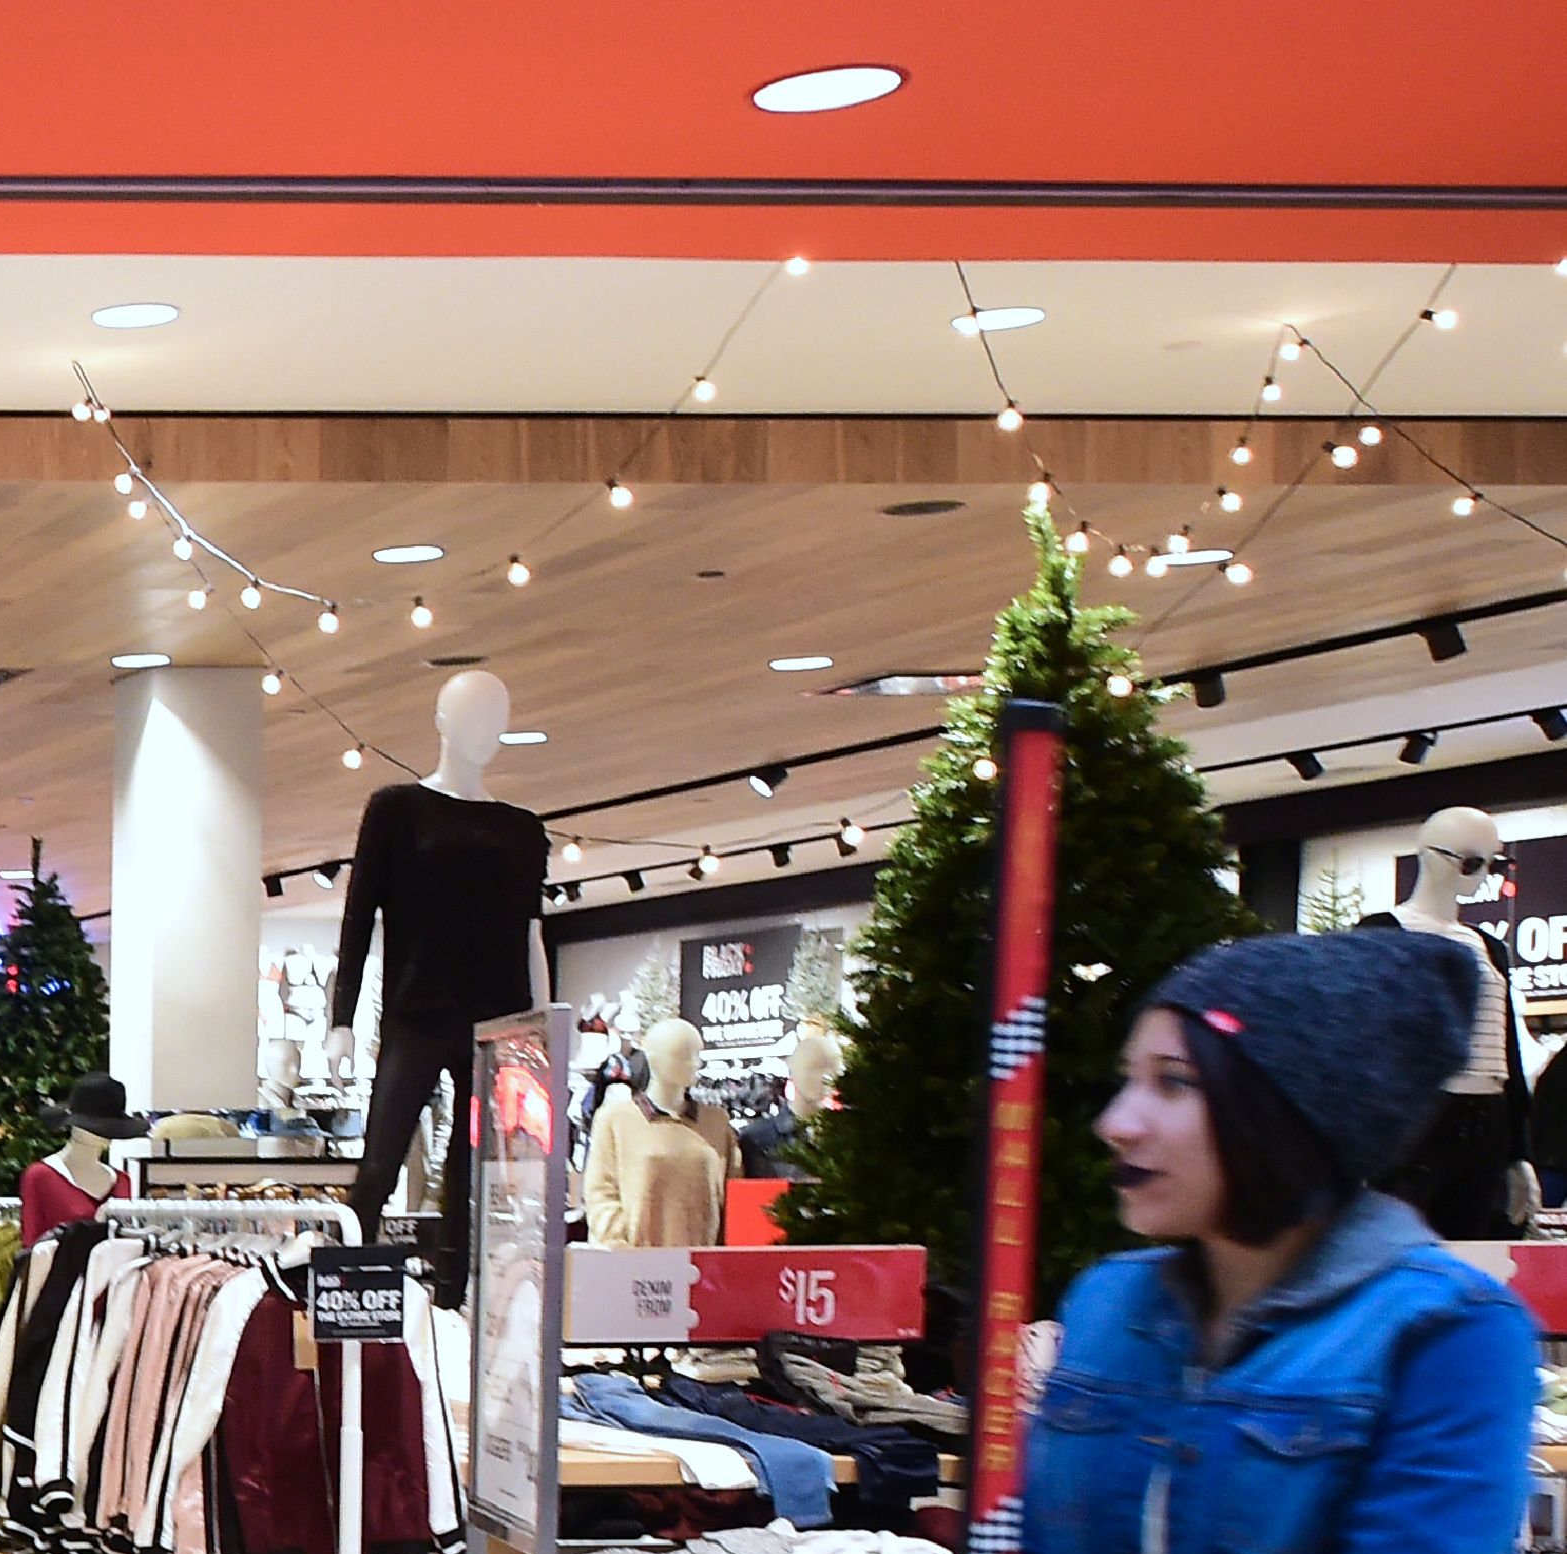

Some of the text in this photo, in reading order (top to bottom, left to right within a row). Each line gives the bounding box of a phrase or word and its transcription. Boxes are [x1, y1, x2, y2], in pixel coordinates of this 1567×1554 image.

[701, 984, 784, 1023] 40% OFF
[632, 1279, 673, 1297] DENIM
[779, 1265, 837, 1326] $15
[316, 1289, 402, 1310] 40% OFF
[636, 1299, 672, 1318] FROM
